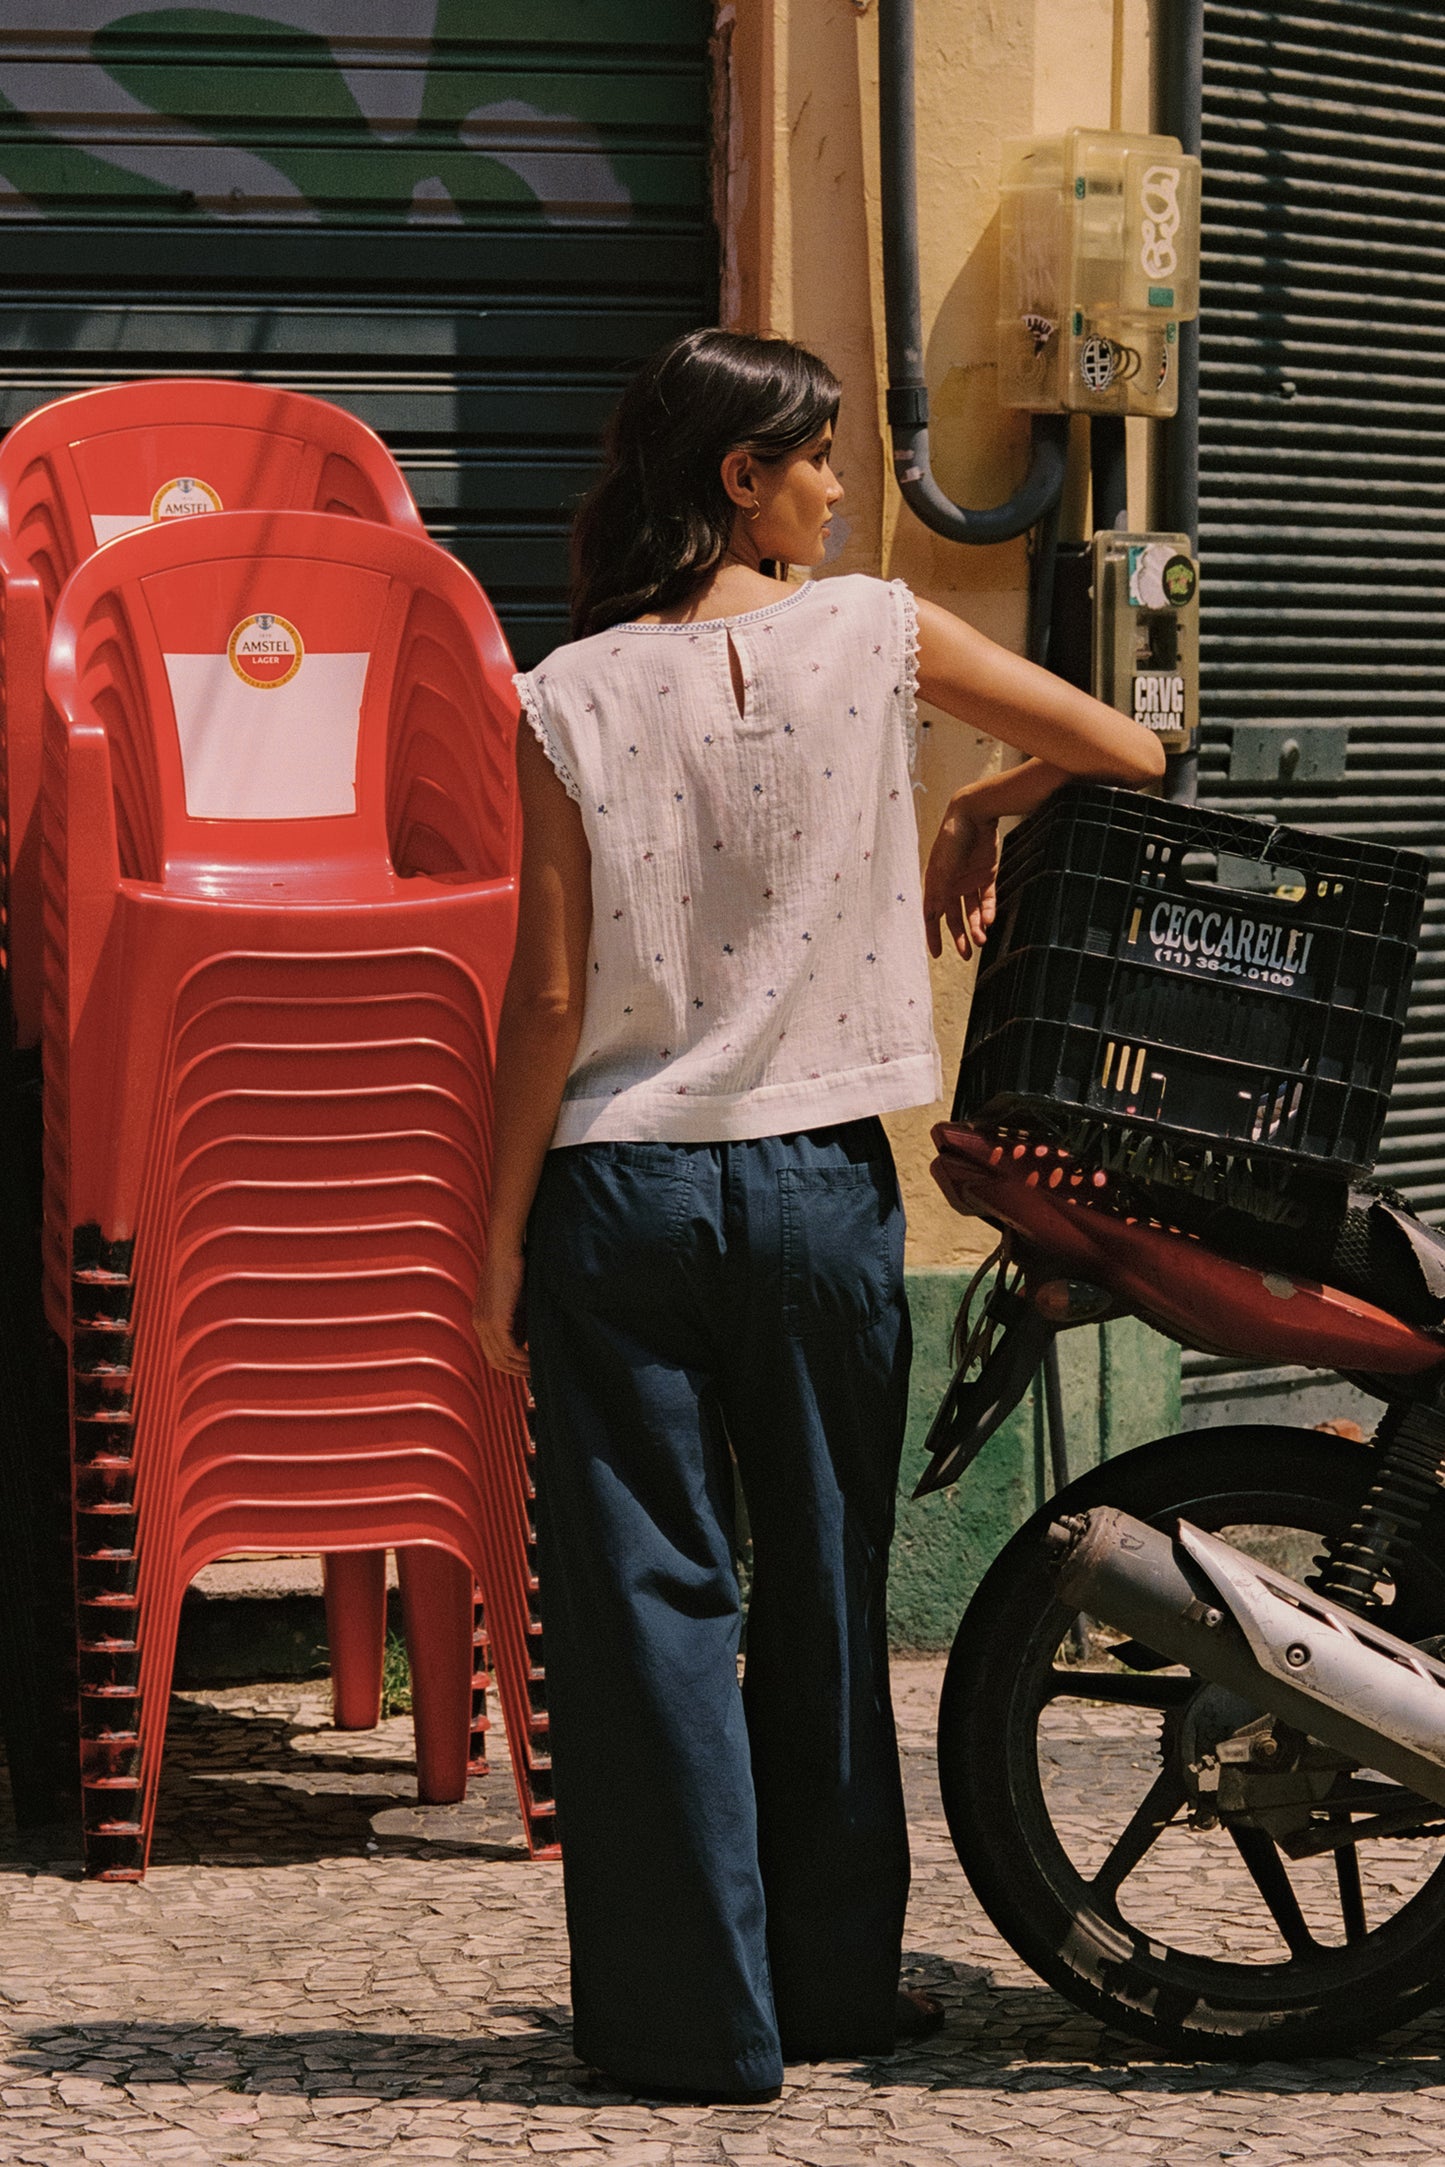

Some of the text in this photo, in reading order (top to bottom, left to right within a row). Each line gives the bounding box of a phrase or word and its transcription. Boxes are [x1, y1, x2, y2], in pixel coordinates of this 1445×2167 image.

[165, 503, 208, 514] AMSTEL
[242, 641, 289, 652] AMSTEL
[1135, 676, 1184, 713] CRVG
[1135, 712, 1183, 731] CASUAL
[1149, 902, 1314, 975] CECCARELLI
[1154, 948, 1294, 987] (11) 3644.0100
